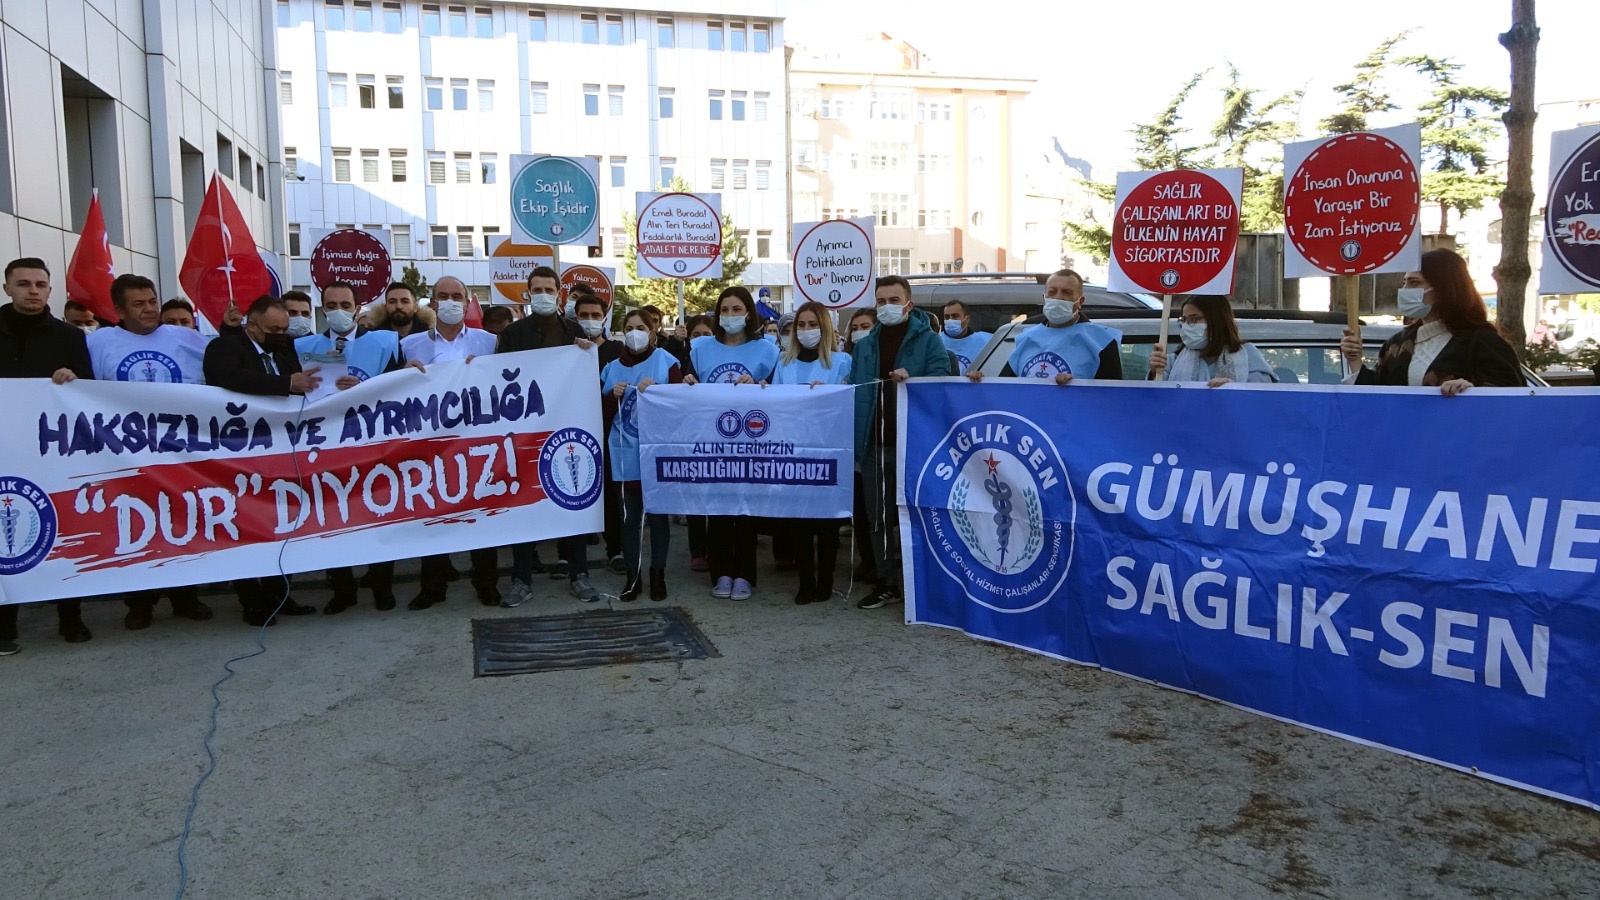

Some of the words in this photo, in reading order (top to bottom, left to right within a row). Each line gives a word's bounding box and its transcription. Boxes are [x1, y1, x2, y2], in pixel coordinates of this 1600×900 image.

[534, 179, 575, 197] Sağlık
[1303, 172, 1342, 192] İnsan
[1346, 168, 1403, 186] Onuruna
[1153, 181, 1202, 200] SAĞLIK
[520, 199, 549, 217] Ekip
[553, 197, 590, 217] İşidir
[1314, 196, 1365, 214] Yaraşır
[1369, 190, 1392, 208] Bir
[1564, 191, 1594, 212] Yok
[651, 208, 673, 217] Emek
[676, 208, 707, 218] Burada!
[1121, 204, 1211, 223] ÇALIŞANLARI
[1214, 204, 1233, 220] BU
[646, 219, 662, 229] Alın
[664, 220, 680, 229] Teri
[682, 221, 713, 230] Burada!
[1123, 224, 1180, 242] ÜLKENİN
[1183, 226, 1228, 242] HAYAT
[1304, 223, 1334, 239] Zam
[1338, 216, 1402, 238] İstiyoruz
[686, 232, 716, 242] Burada!
[815, 238, 853, 254] Ayrımcı
[321, 247, 353, 260] İşimize
[355, 248, 380, 262] Aşığız
[643, 245, 676, 255] ADALET
[678, 245, 716, 255] NEREDE?
[1124, 245, 1221, 264] SİGORTASIDIR
[328, 262, 375, 275] Ayrımcılığa
[806, 255, 863, 269] Politikalara
[493, 271, 519, 281] Adalet
[830, 272, 865, 287] Diyoruz
[157, 354, 176, 370] SEN
[38, 402, 273, 456] HAKSIZLIĞA
[285, 416, 327, 447] VE
[339, 367, 546, 444] AYRIMCILIĞA
[543, 431, 577, 461] SAĞLIK
[580, 434, 599, 455] SEN
[692, 442, 725, 455] ALIN
[728, 439, 795, 456] TERİMİZİN
[935, 423, 1012, 481] SAĞLIK
[1016, 435, 1058, 490] SEN
[662, 458, 746, 482] KARŞILIĞINI
[748, 459, 830, 481] İSTİYORUZ!
[269, 436, 521, 535] DİYORUZ!
[22, 484, 48, 510] SEN
[1086, 452, 1600, 574] GÜMÜŞHANE
[941, 539, 952, 553] VE
[975, 578, 1004, 596] HİZMET
[1005, 568, 1050, 599] ÇALIŞANLARI
[1106, 555, 1550, 698] SAĞLIK-SEN
